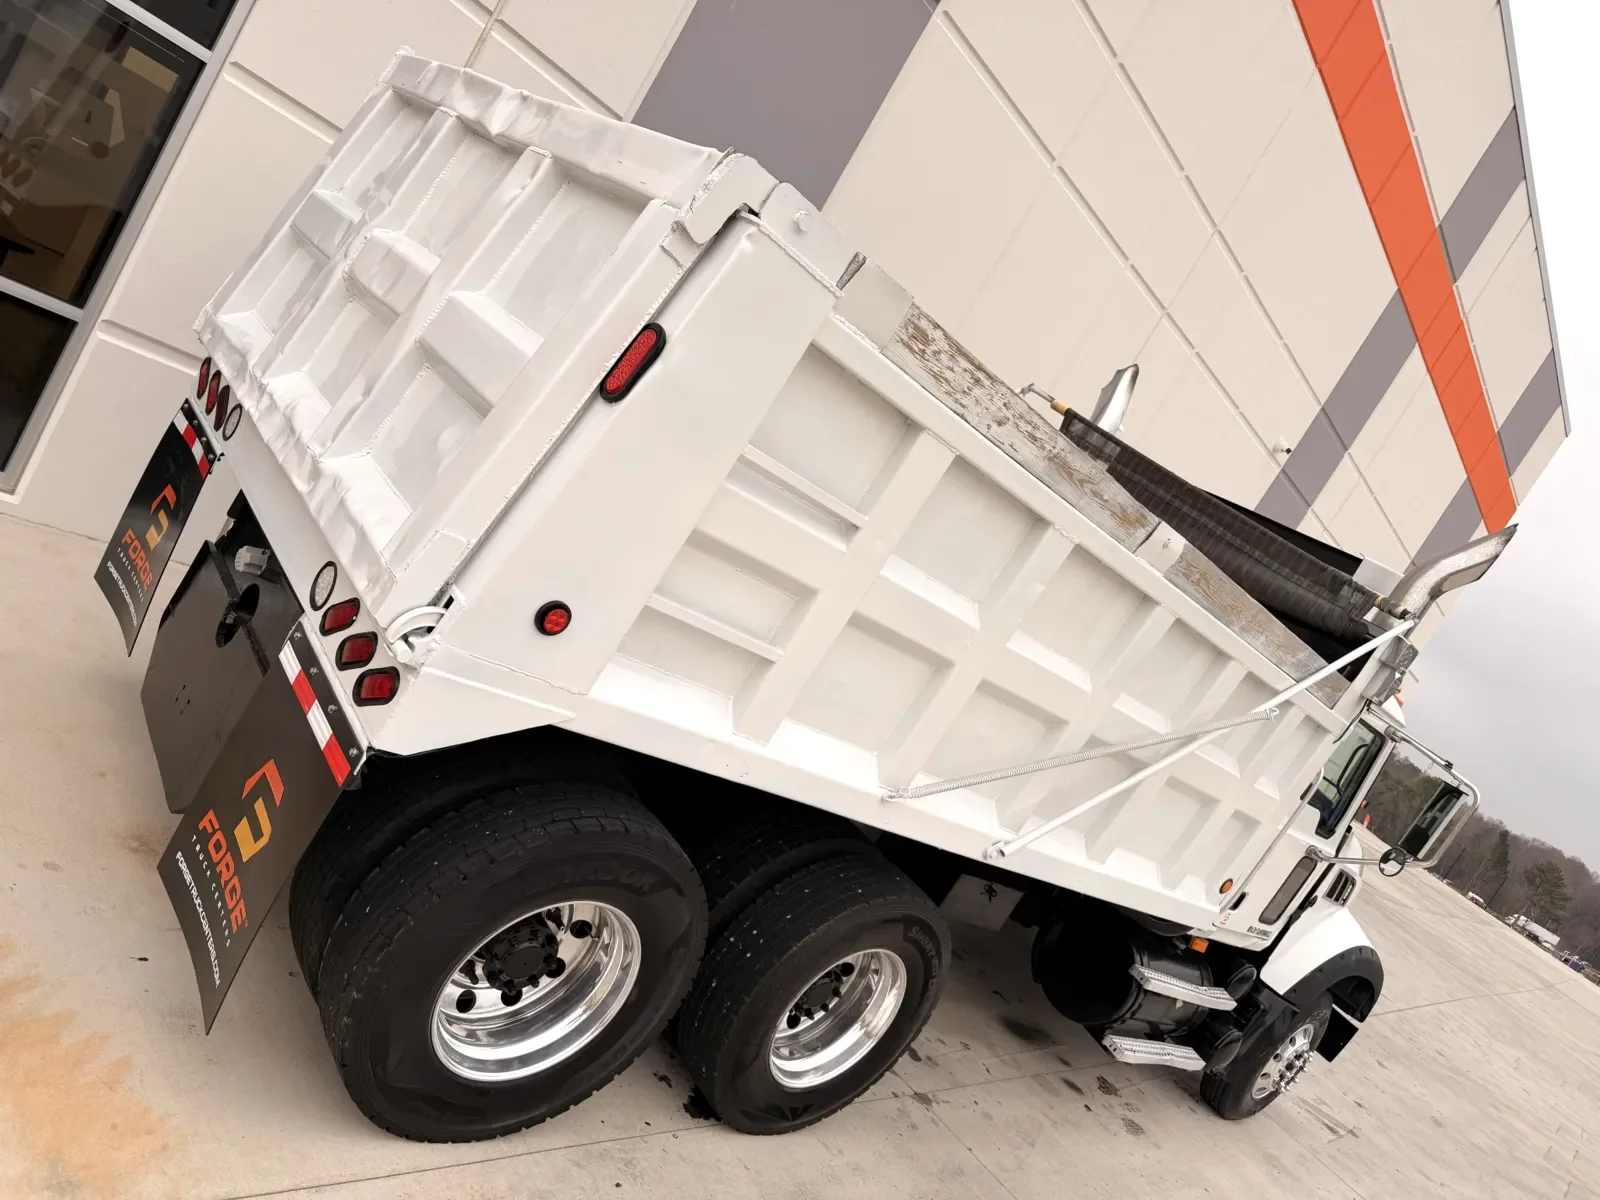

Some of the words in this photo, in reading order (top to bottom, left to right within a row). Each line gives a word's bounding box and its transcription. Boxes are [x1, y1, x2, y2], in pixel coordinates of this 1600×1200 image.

[121, 528, 153, 592] FORGE
[175, 851, 221, 989] FORGETRUCKCENTERS.COM
[191, 834, 211, 879] TRUCK
[211, 883, 231, 947] CENTERS
[198, 808, 247, 934] FORGE
